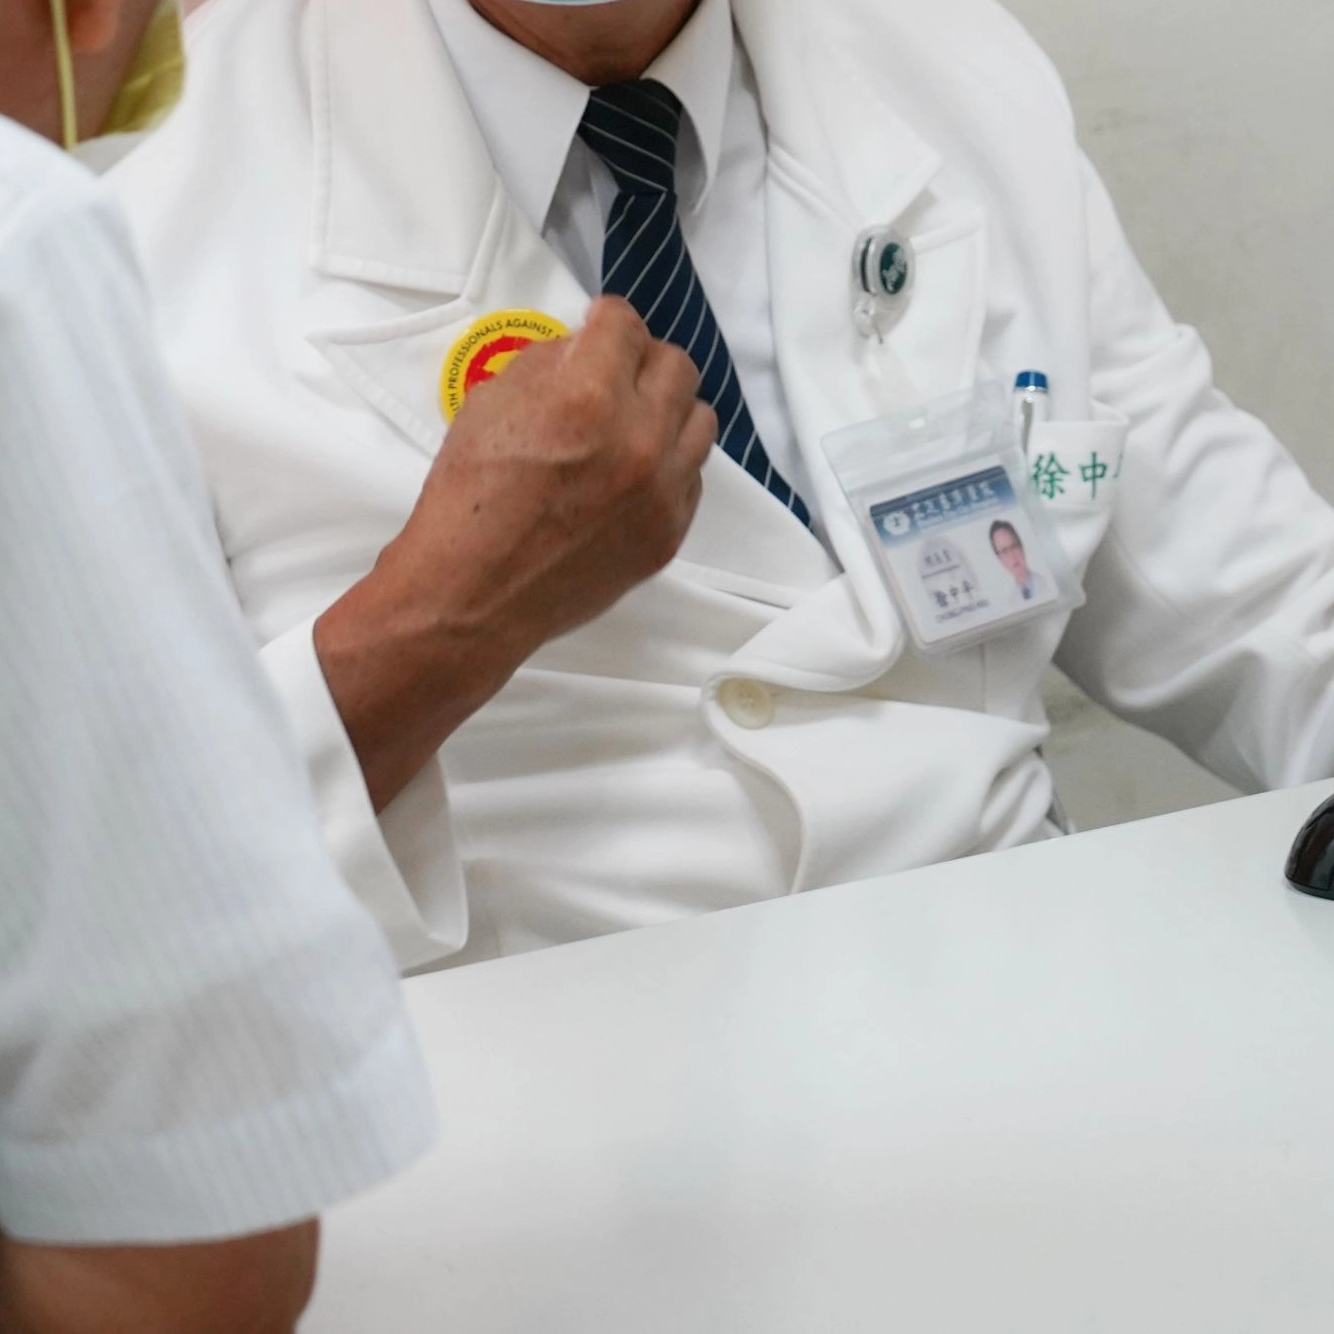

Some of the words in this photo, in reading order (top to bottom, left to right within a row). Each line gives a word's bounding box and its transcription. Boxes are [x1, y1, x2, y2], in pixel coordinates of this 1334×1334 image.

[447, 320, 503, 390] PROFESSIONALS
[505, 317, 553, 338] AGAINST
[1031, 450, 1123, 500] 徐中
